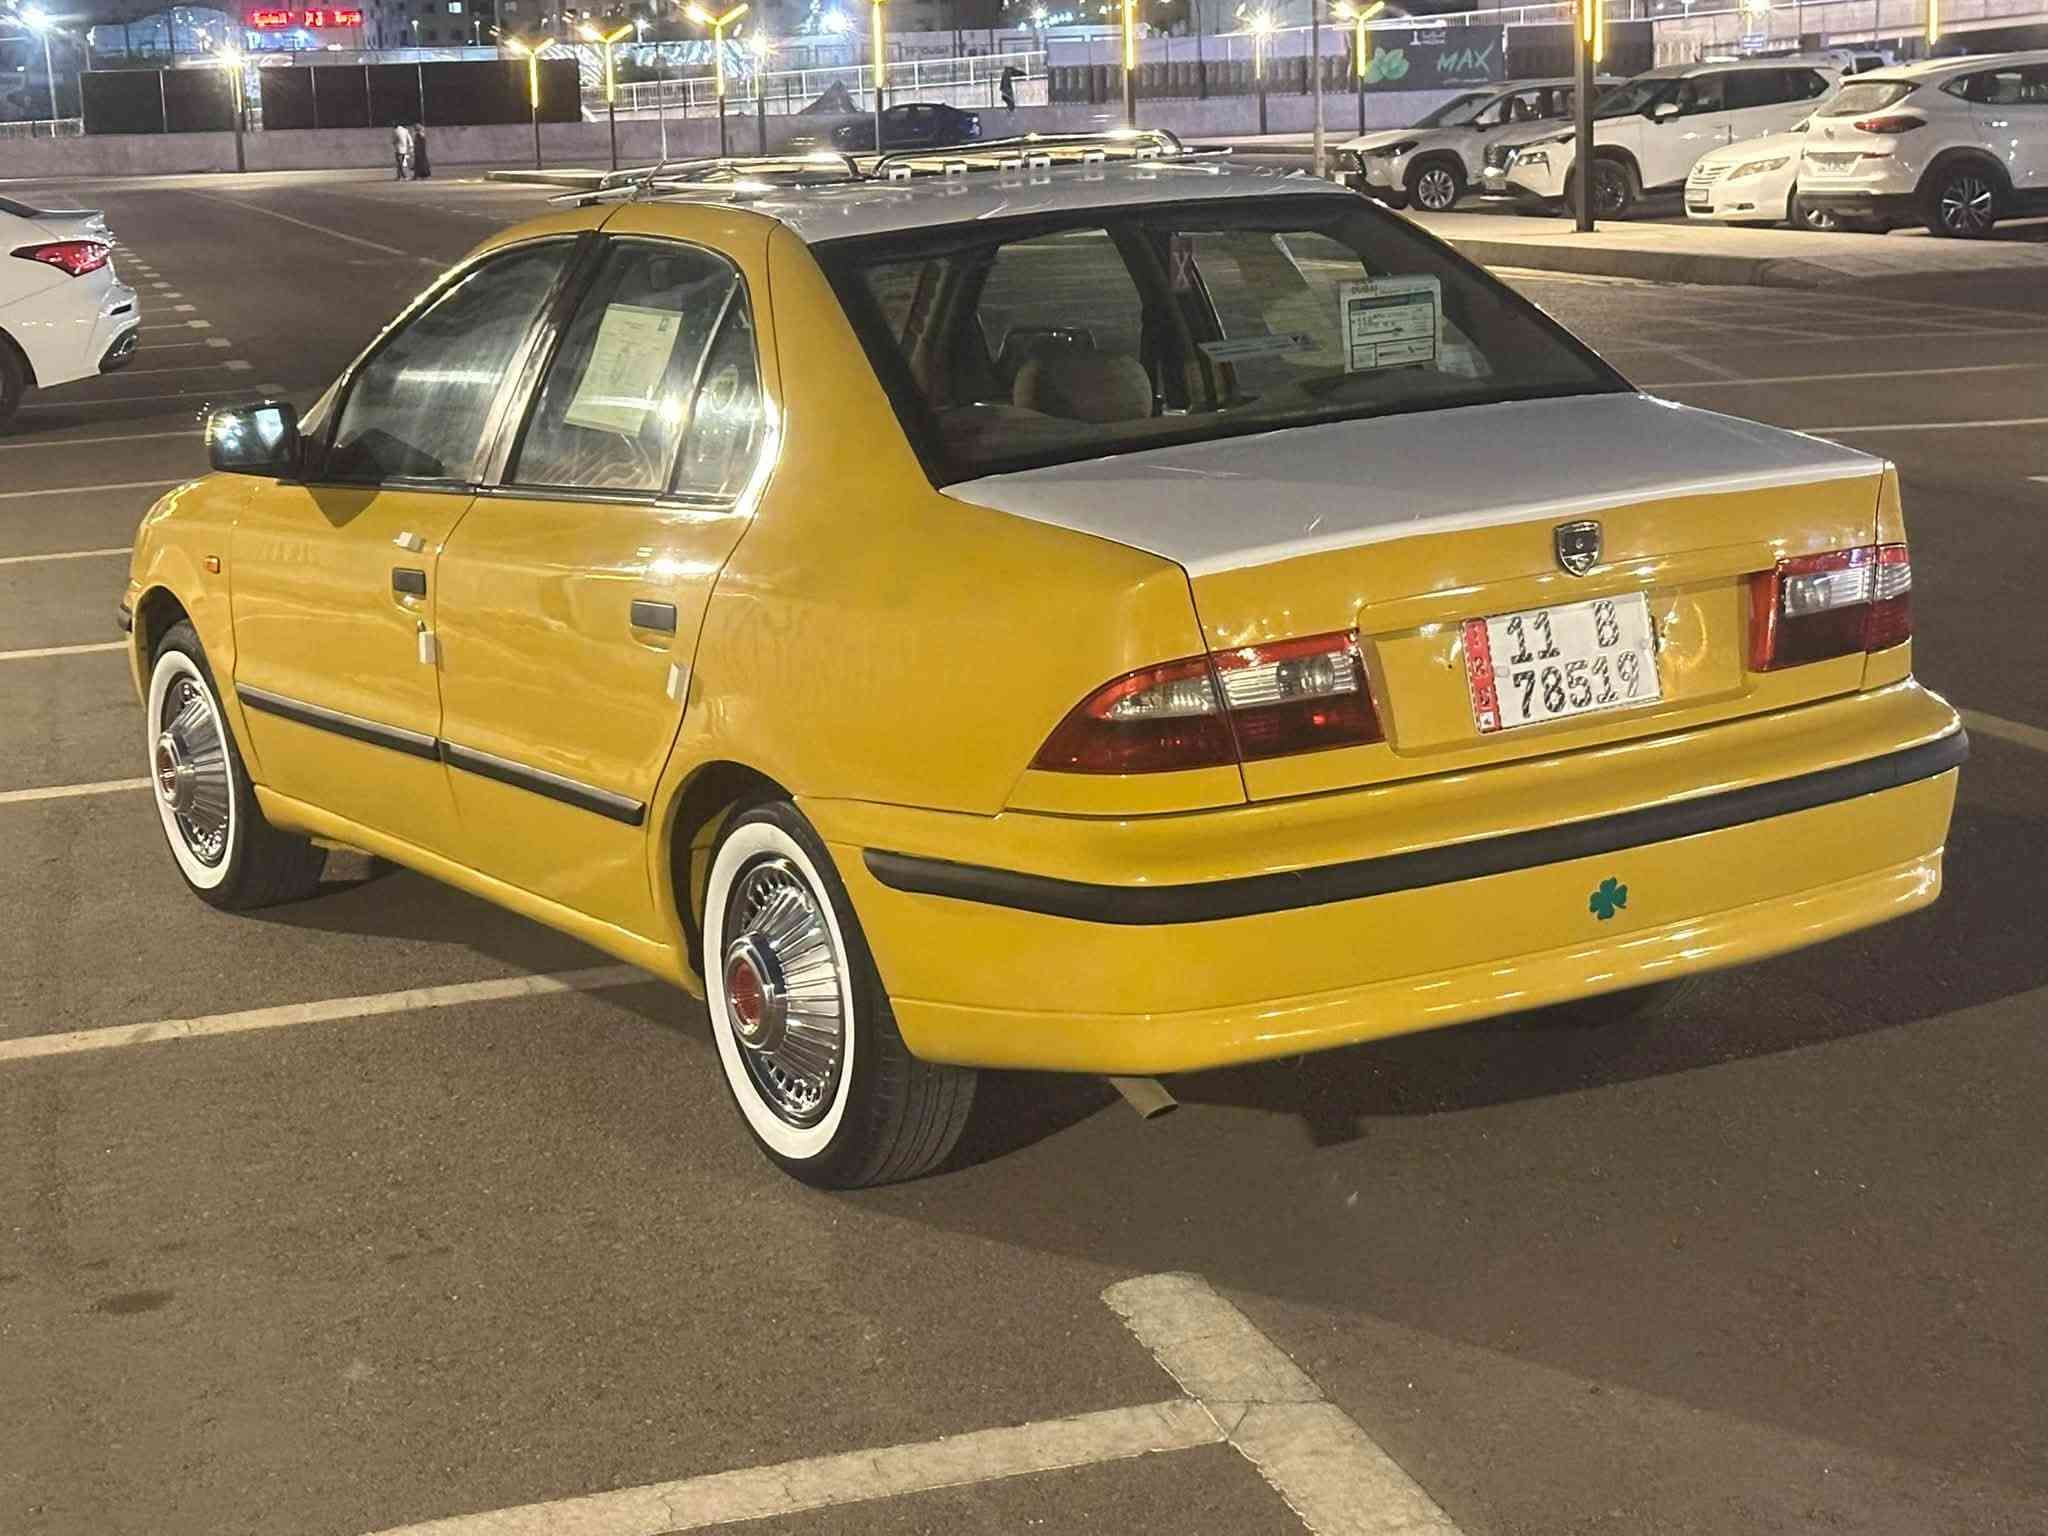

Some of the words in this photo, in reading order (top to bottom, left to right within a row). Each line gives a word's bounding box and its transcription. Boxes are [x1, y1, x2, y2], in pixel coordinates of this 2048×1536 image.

[1437, 40, 1495, 73] MAX
[1507, 611, 1560, 664] 11
[1512, 650, 1639, 718] 78519
